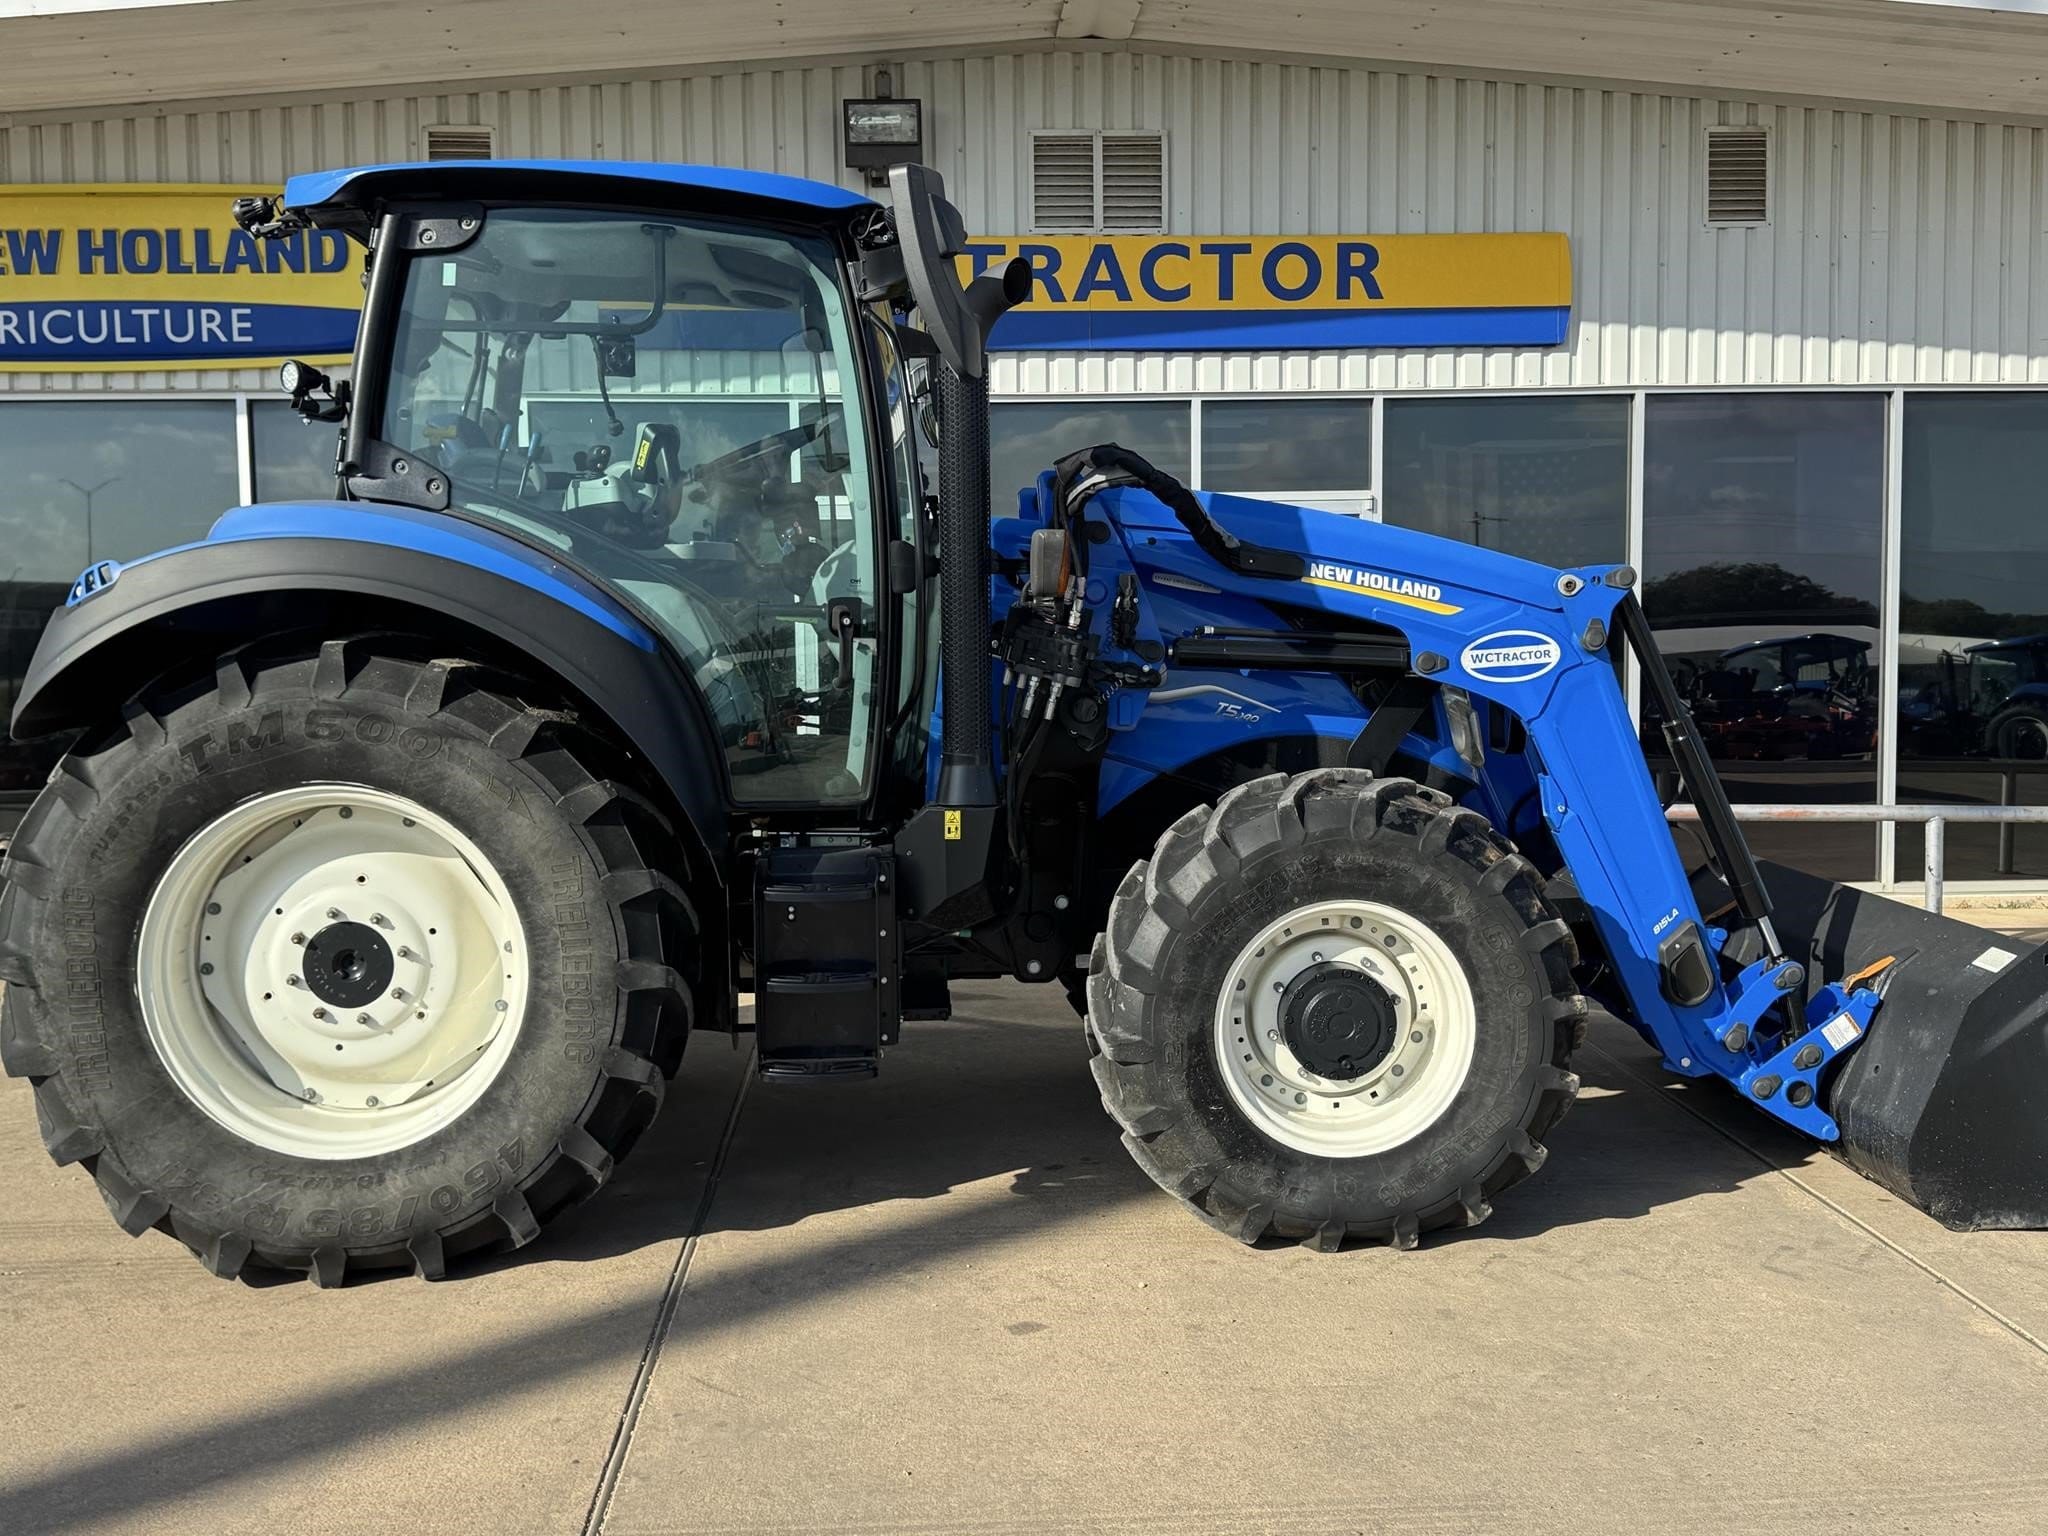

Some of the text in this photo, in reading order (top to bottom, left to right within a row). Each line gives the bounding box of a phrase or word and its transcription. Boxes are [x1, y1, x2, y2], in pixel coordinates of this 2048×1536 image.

[77, 228, 349, 275] HOLLAND
[1309, 562, 1442, 602] NEW HOLLAND
[1470, 648, 1552, 665] WCTRACTOR
[1652, 907, 1679, 935] 815LA
[550, 855, 596, 1065] TRELLEBORG
[62, 885, 113, 1099] TRELLEBORG
